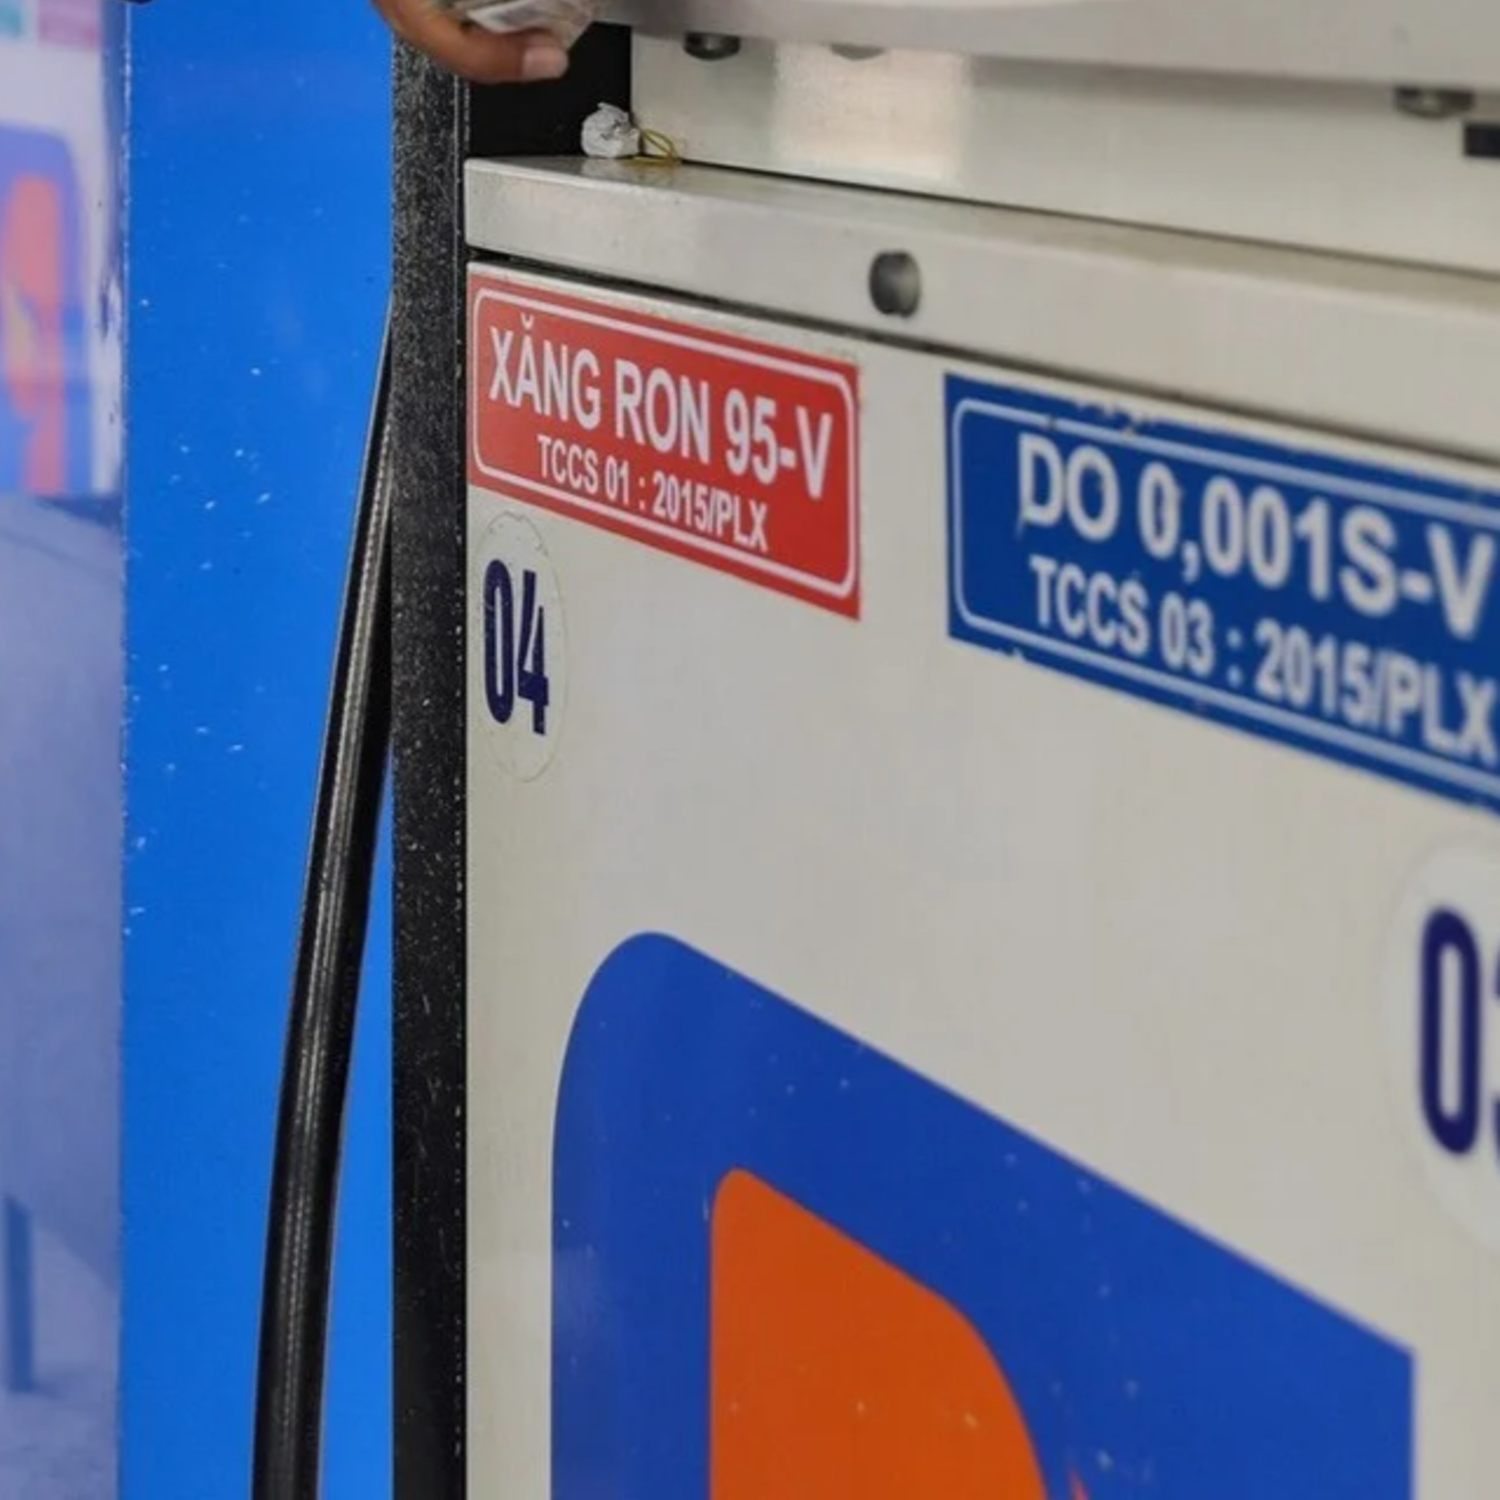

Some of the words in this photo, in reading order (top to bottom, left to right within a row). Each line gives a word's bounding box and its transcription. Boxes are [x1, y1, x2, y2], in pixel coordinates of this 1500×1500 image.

[489, 314, 601, 429] XĂNG
[615, 359, 710, 463] RON
[724, 389, 833, 498] 95-V
[537, 434, 598, 495] TCCS
[605, 456, 629, 505] 01
[652, 472, 769, 553] 2015/PLX
[1018, 431, 1120, 541] DO
[1137, 461, 1496, 640] 0,001S-V
[484, 559, 550, 736] 04
[1030, 555, 1150, 656] TCCS
[1160, 593, 1215, 677] 03
[1255, 619, 1499, 765] 2015/PLX
[1420, 906, 1500, 1174] 0
